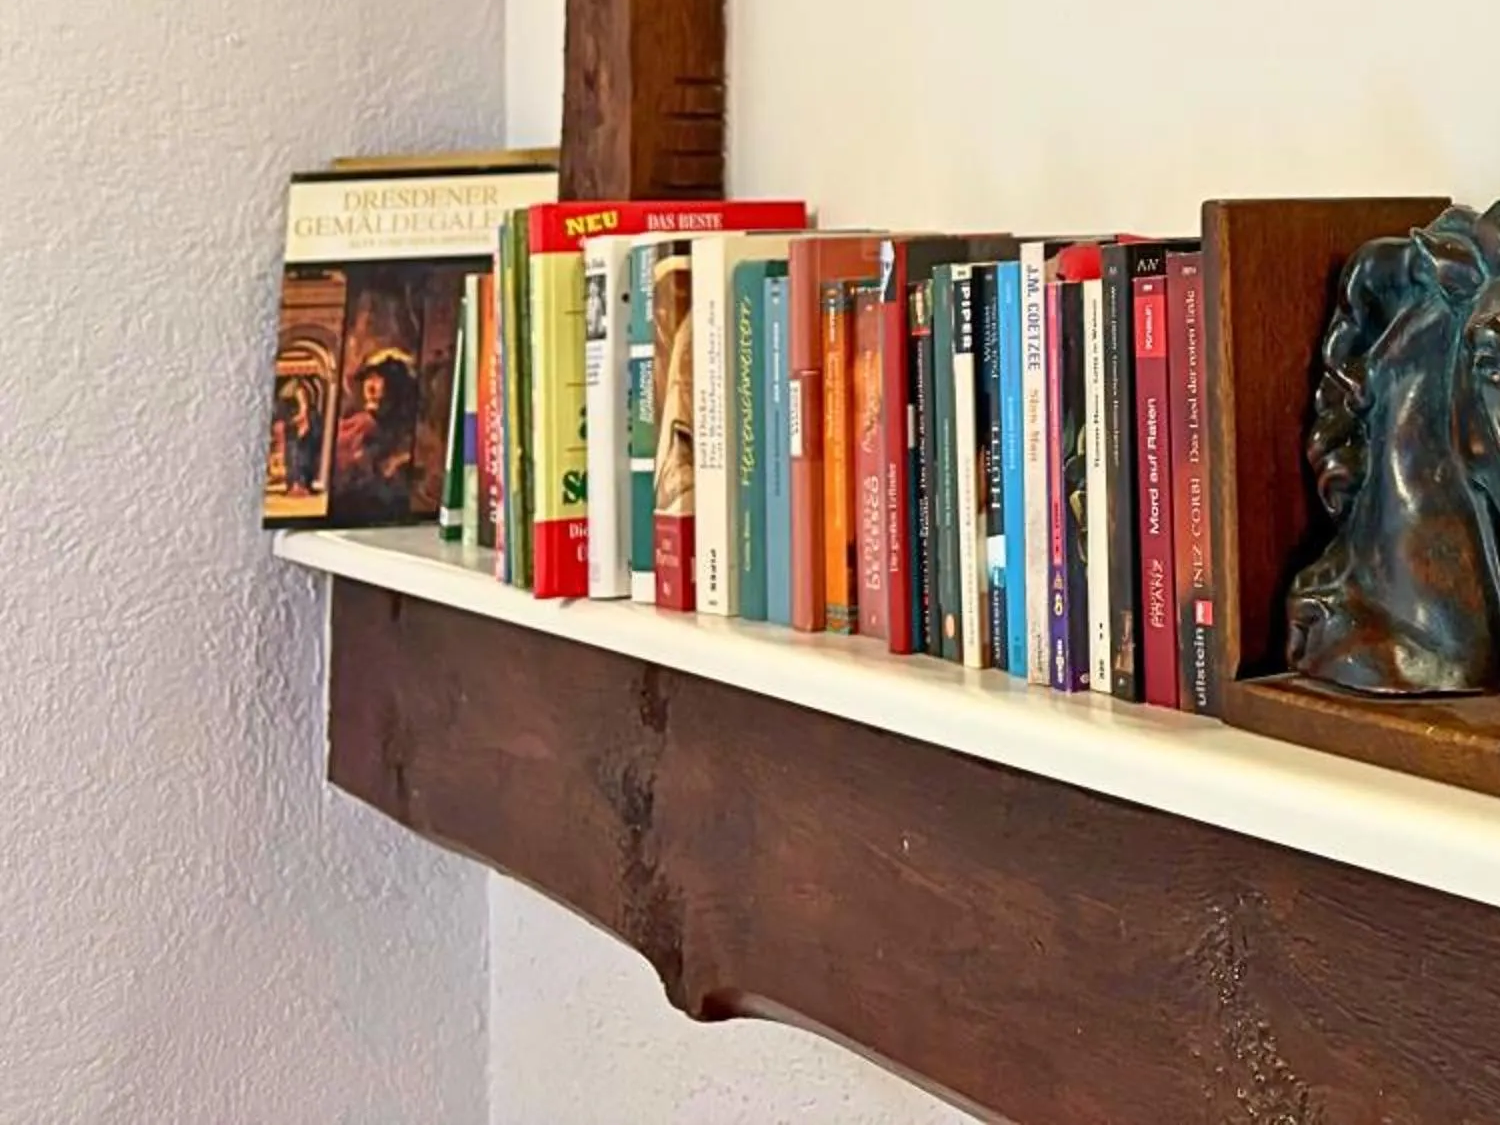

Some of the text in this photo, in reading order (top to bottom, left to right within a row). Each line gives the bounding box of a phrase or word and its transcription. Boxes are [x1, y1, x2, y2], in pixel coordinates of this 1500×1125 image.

[343, 185, 499, 213] DRESDENER
[565, 211, 618, 236] NEU
[648, 213, 722, 230] DAS BESTE
[961, 285, 972, 348] PIPER
[1027, 302, 1041, 371] COETZEE
[1146, 398, 1160, 535] Mord auf Raten
[1192, 544, 1204, 588] INEZ
[1193, 626, 1207, 706] ullstein
